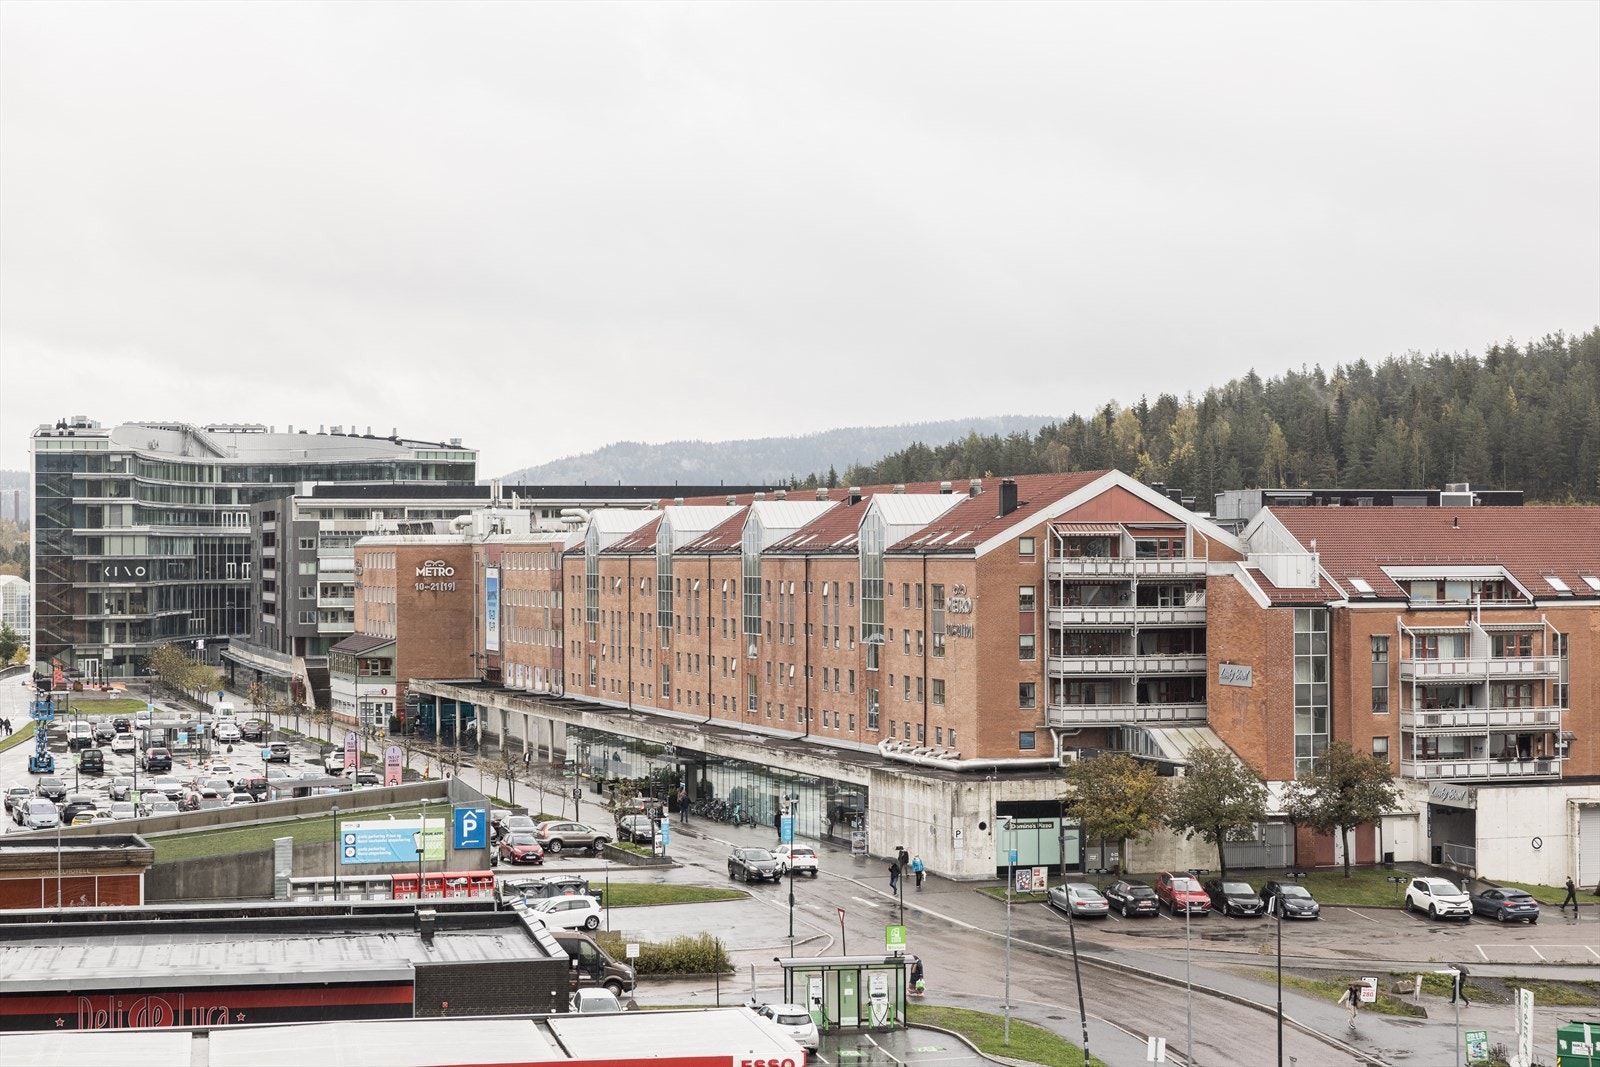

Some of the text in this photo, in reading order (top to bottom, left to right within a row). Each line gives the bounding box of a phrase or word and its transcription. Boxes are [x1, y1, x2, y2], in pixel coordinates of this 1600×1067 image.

[415, 567, 455, 577] METRO
[463, 819, 477, 838] P
[955, 829, 962, 838] P
[741, 1058, 796, 1067] ESSO
